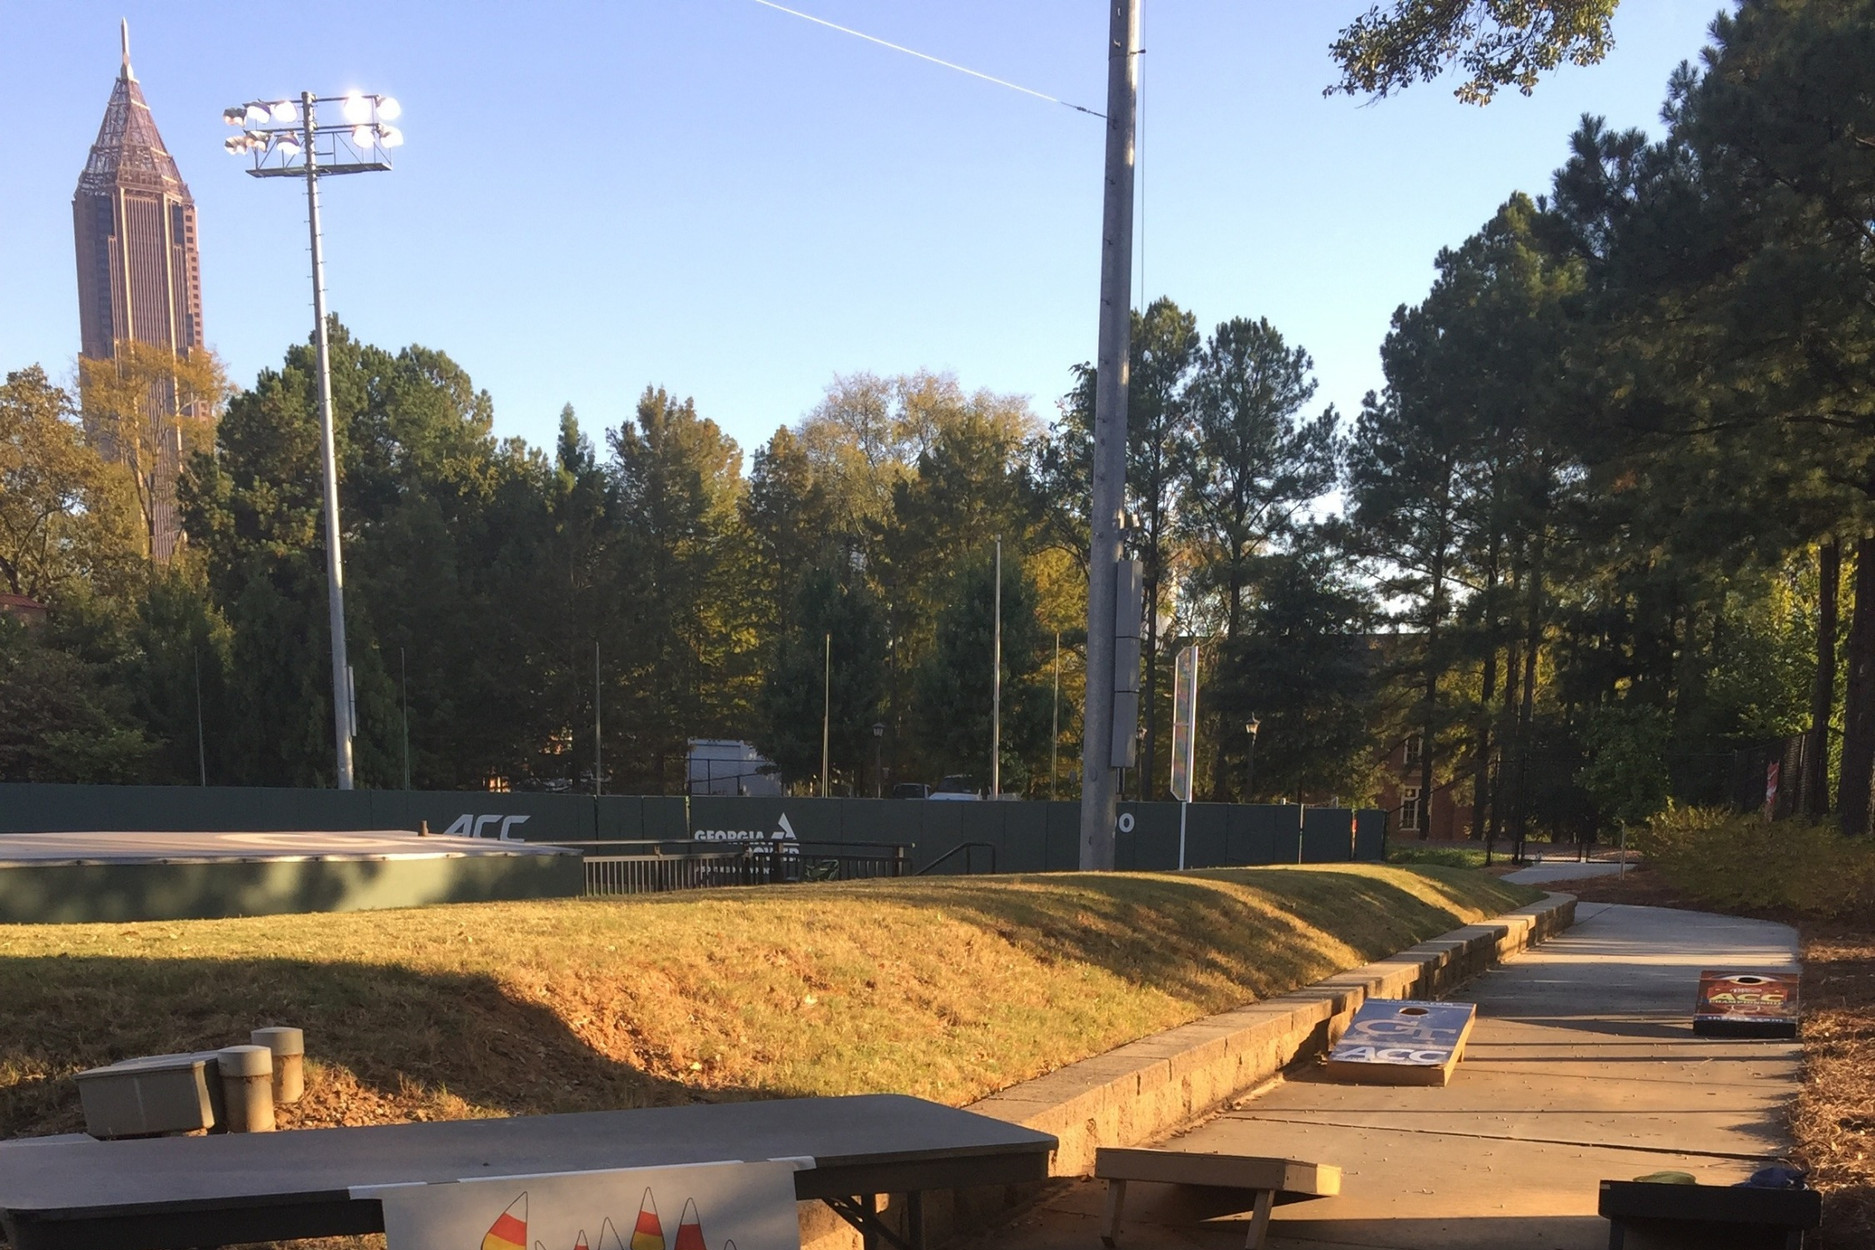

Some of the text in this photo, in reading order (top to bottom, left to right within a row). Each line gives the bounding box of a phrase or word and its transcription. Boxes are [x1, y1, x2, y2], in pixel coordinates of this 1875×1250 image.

[443, 814, 531, 842] ACC
[694, 830, 767, 844] GEORGIA
[1709, 993, 1784, 1003] ACC
[1354, 1019, 1456, 1041] GT
[1336, 1046, 1447, 1063] ACC
